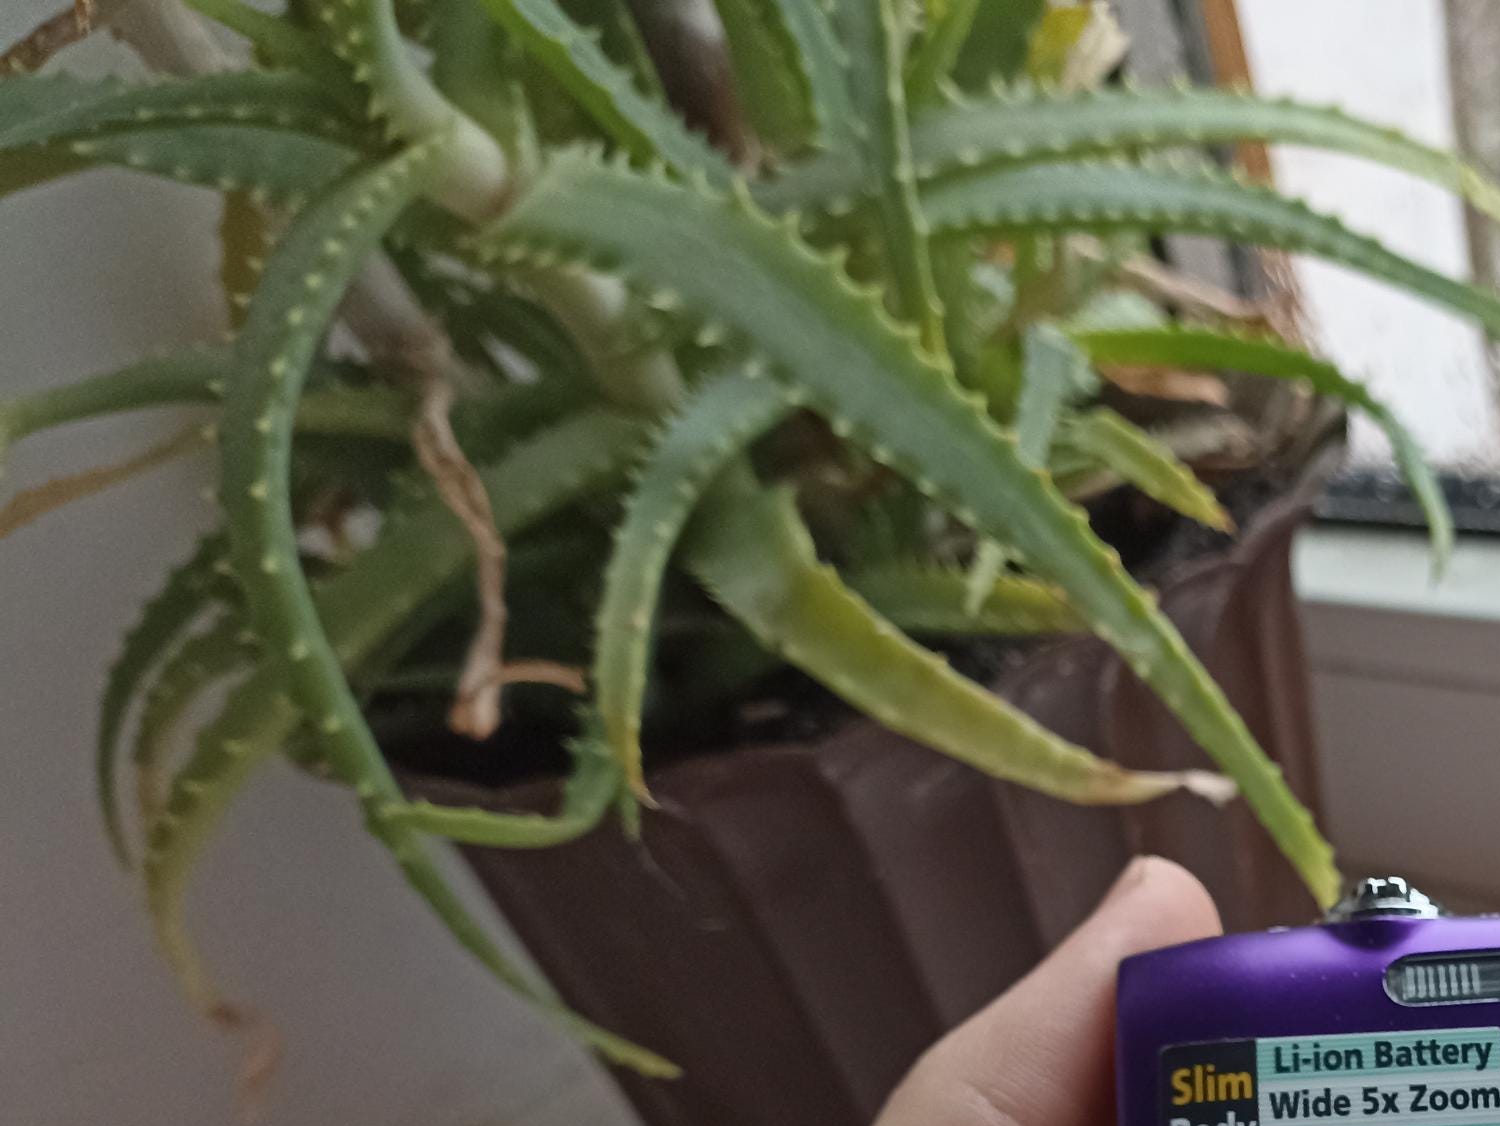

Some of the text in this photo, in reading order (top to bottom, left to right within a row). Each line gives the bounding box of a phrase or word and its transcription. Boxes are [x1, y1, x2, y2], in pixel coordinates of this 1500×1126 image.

[1274, 1039, 1493, 1075] Li-ion Battery
[1170, 1065, 1253, 1106] Slim
[1269, 1083, 1500, 1120] Wide 5x Zoom
